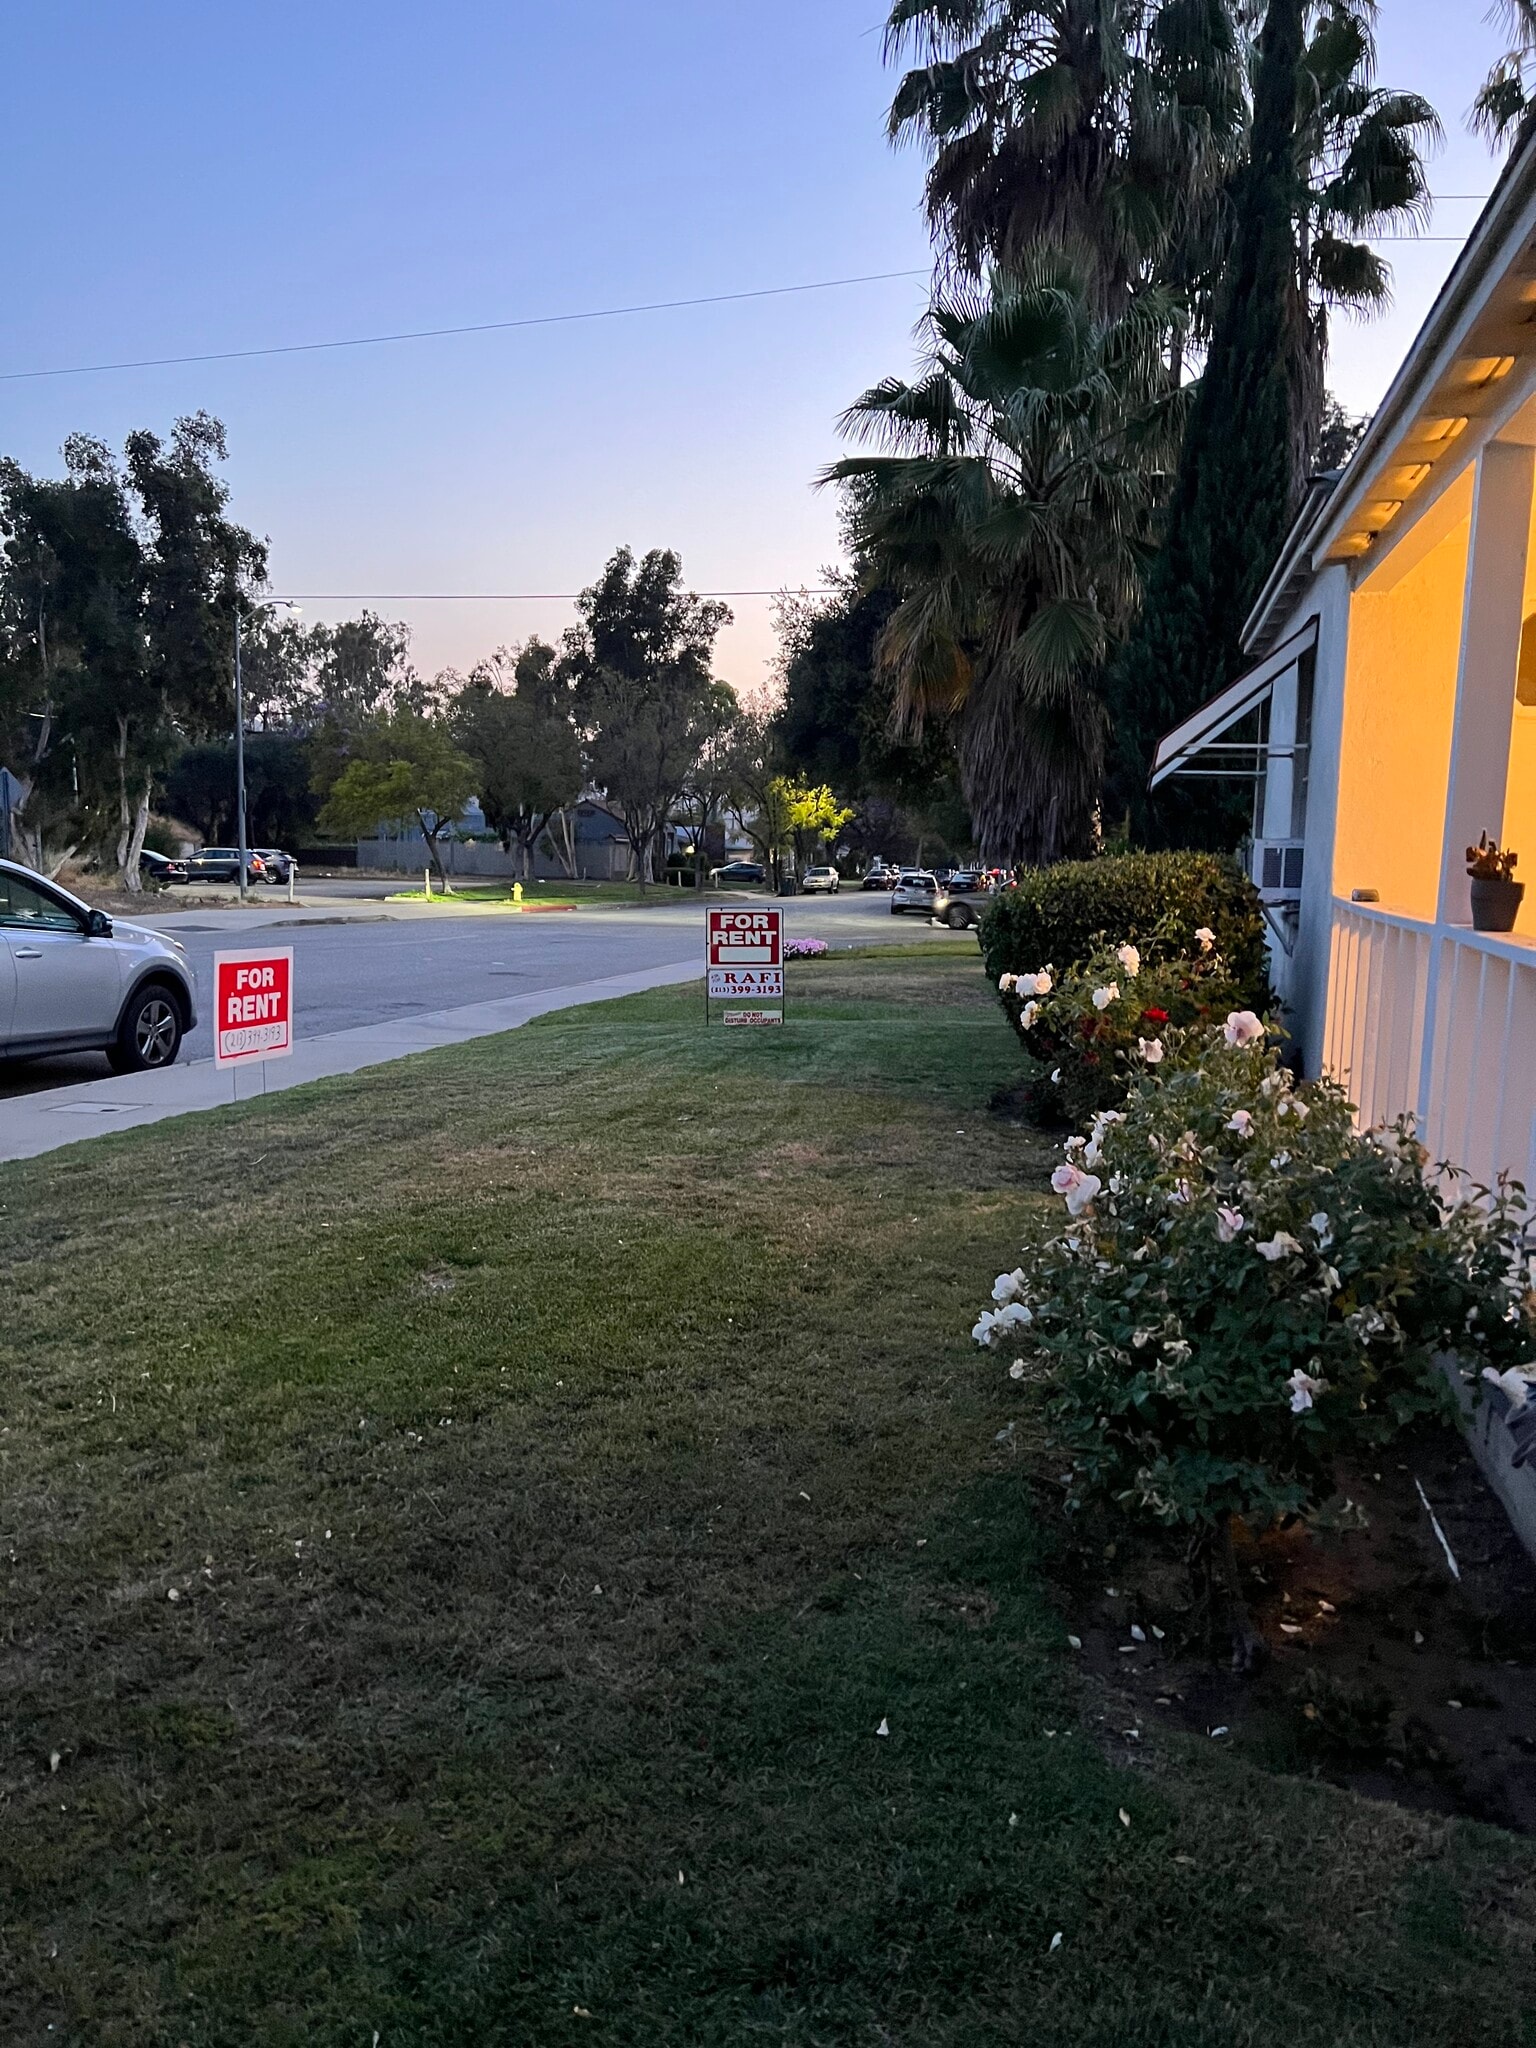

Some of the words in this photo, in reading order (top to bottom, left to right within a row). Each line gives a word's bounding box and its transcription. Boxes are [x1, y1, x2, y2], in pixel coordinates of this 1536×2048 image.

[720, 914, 769, 929] FOR
[712, 930, 777, 945] RENT
[236, 967, 275, 990] FOR
[724, 972, 781, 984] RAFI
[731, 985, 781, 994] 399-3193
[227, 992, 281, 1023] RENT
